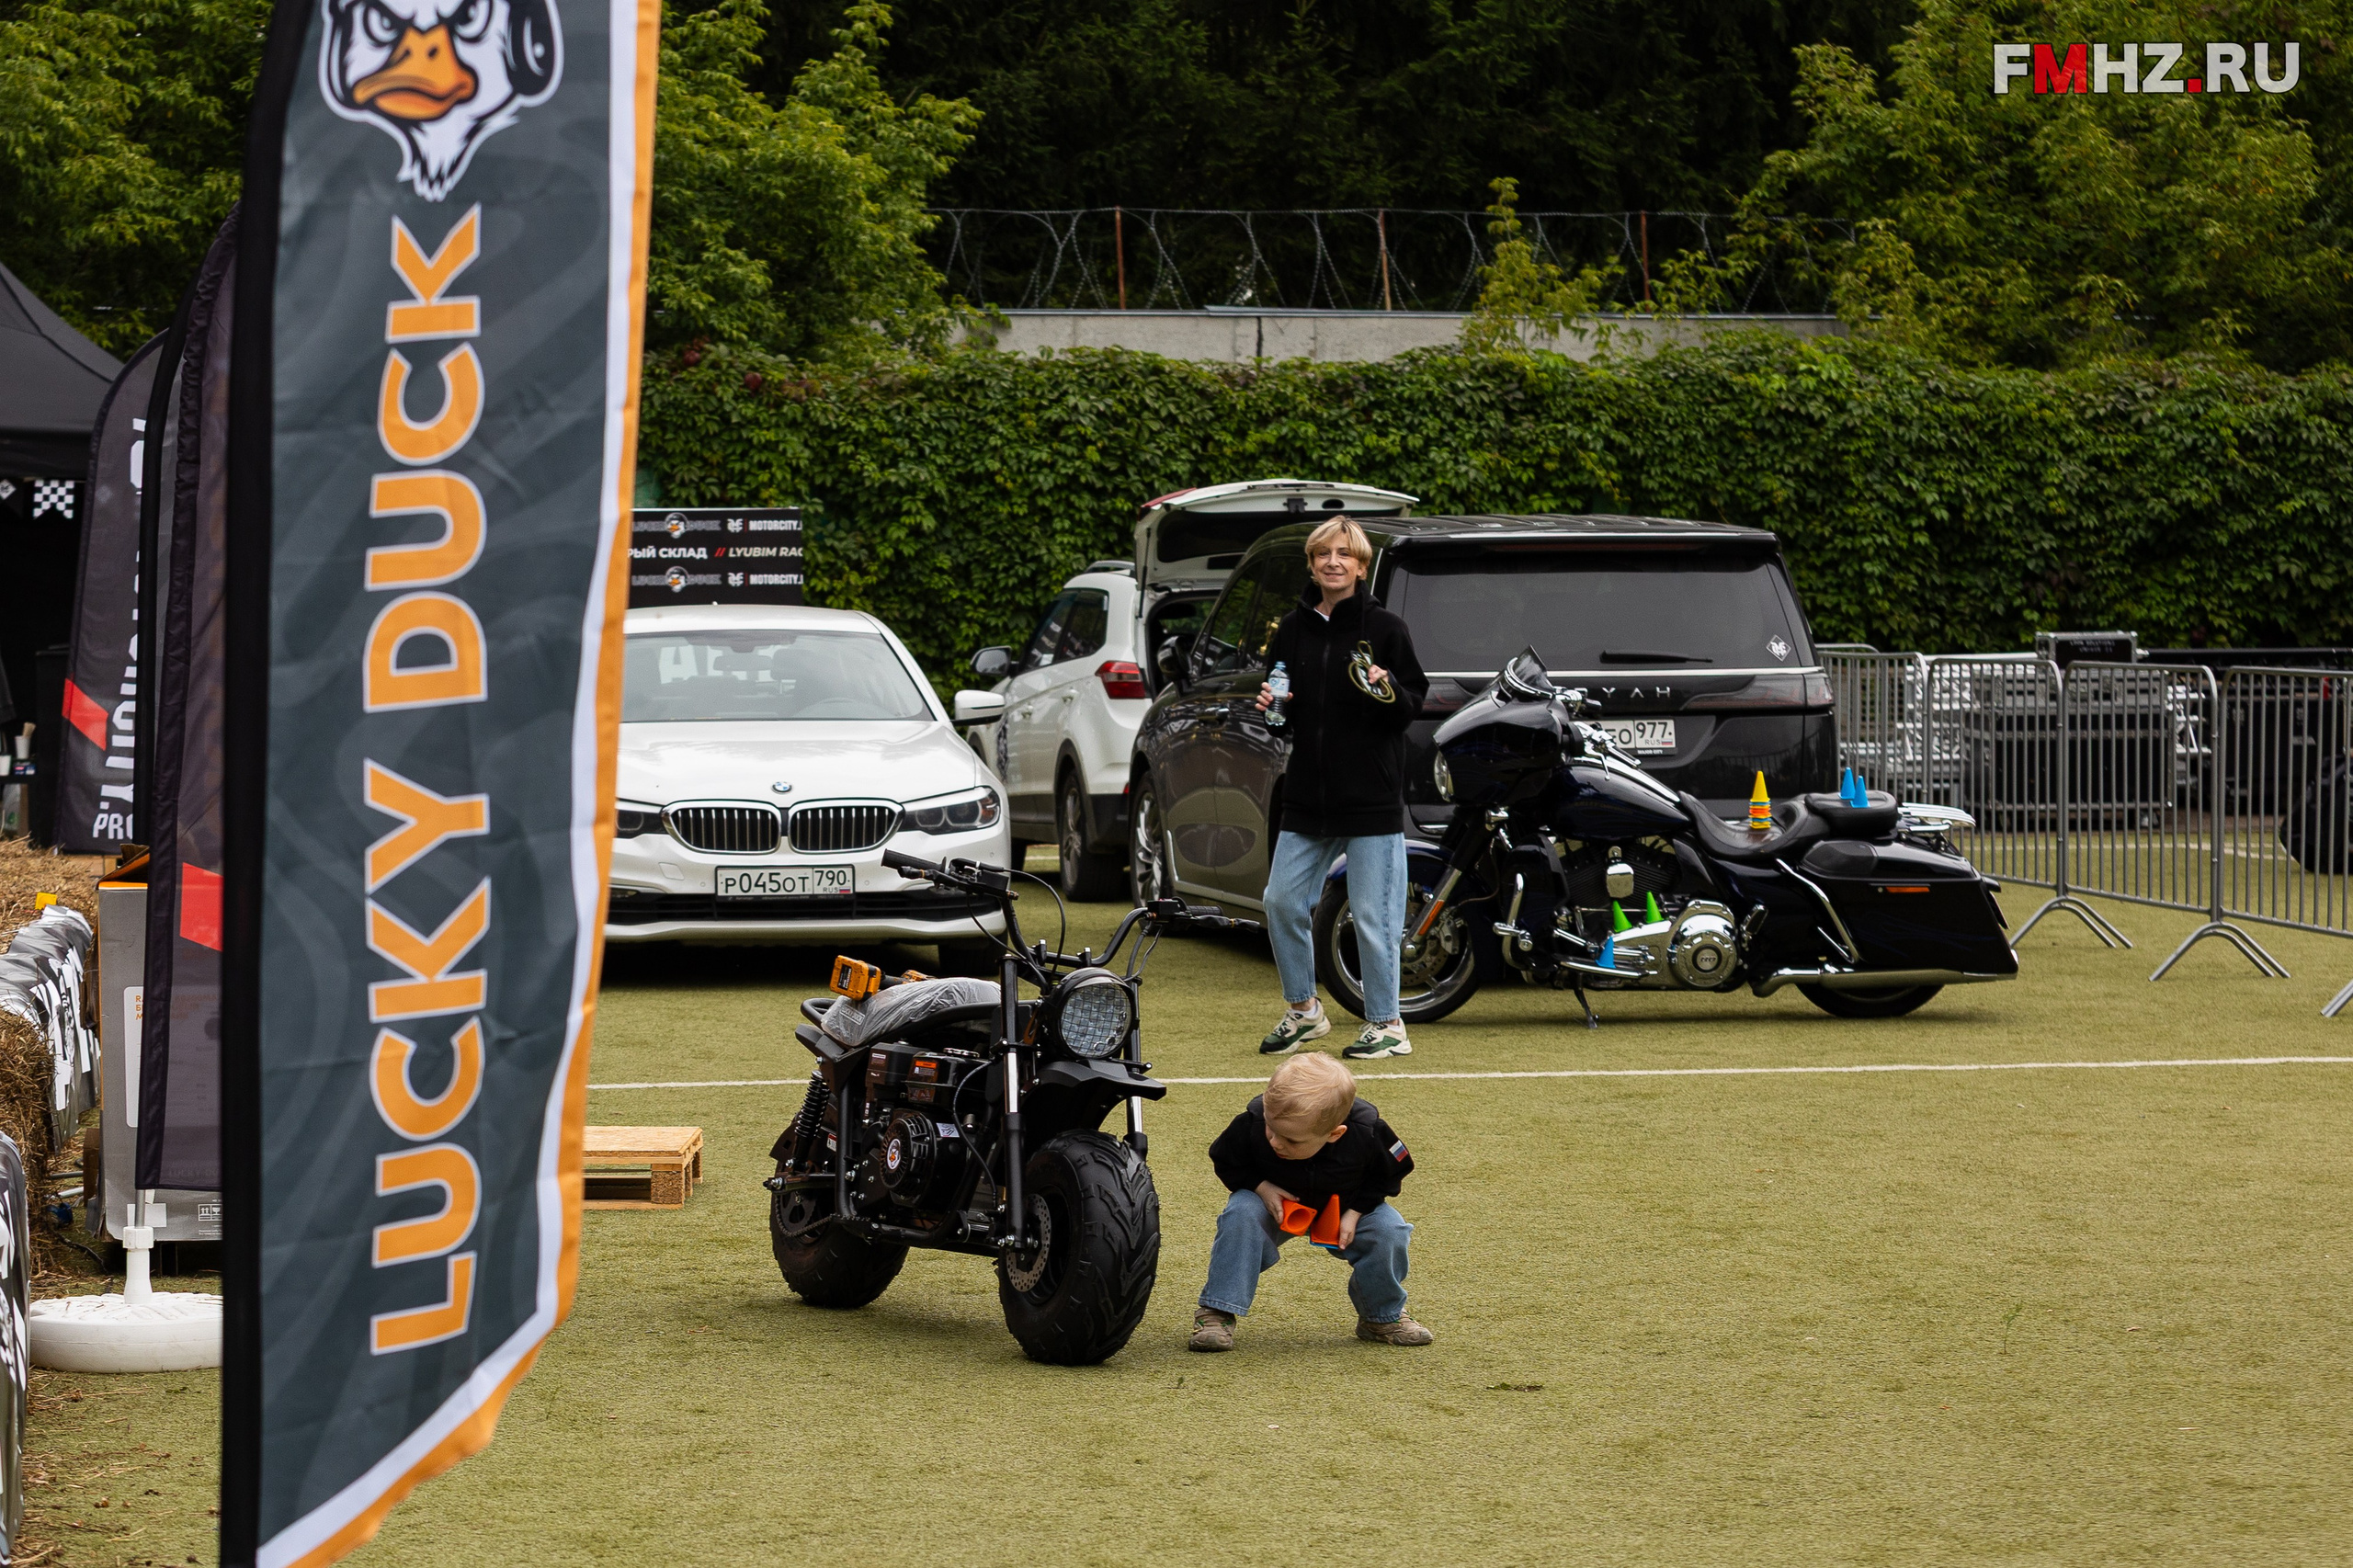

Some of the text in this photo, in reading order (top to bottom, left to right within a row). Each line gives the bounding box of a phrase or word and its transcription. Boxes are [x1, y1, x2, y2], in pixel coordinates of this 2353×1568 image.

[658, 547, 708, 560] СКЛАД
[728, 547, 777, 558] LYUBIM
[1636, 722, 1667, 738] 977
[362, 201, 491, 1356] LUCKY DUCK
[814, 870, 847, 886] 790
